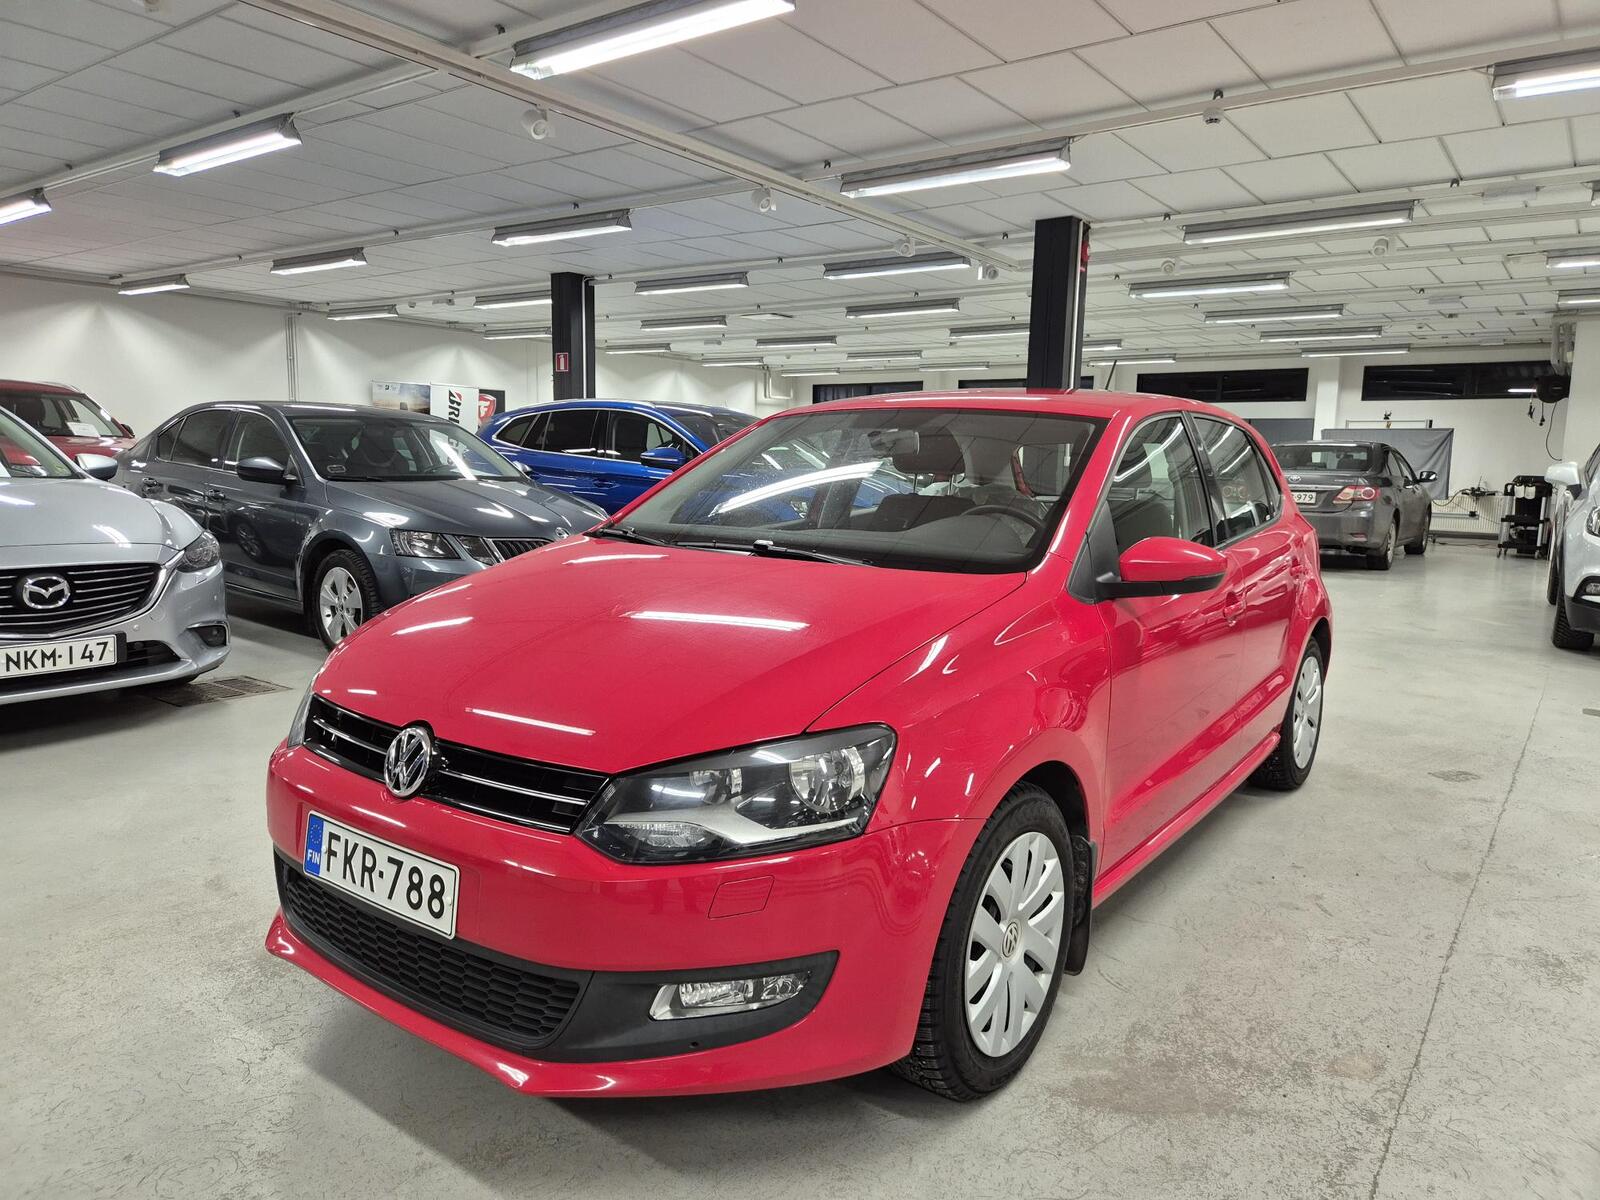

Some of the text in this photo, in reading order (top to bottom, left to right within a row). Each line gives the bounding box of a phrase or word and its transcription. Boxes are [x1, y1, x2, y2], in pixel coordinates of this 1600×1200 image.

[5, 641, 109, 672] NKM-147
[306, 849, 321, 865] FIN
[326, 831, 446, 919] FKR-788
